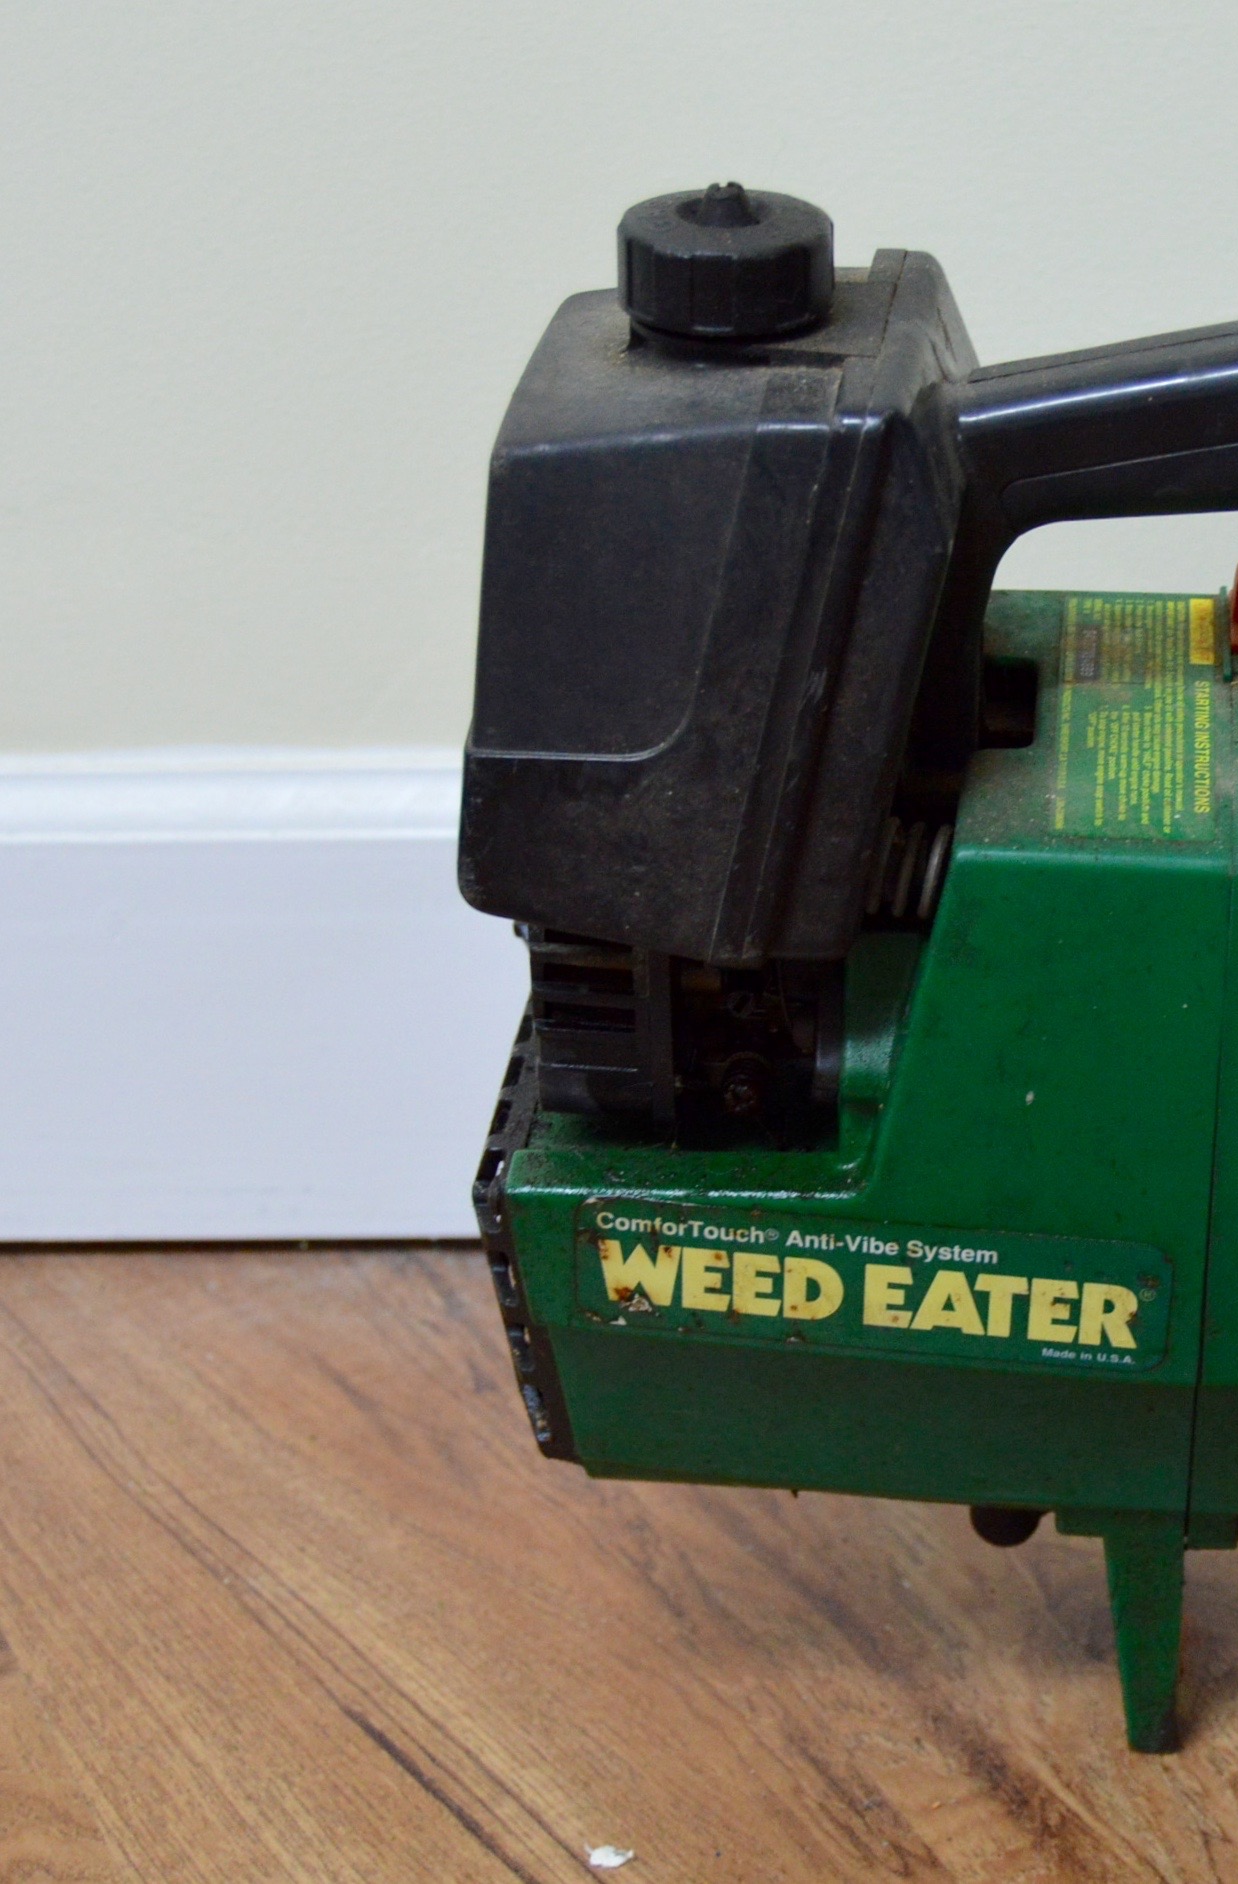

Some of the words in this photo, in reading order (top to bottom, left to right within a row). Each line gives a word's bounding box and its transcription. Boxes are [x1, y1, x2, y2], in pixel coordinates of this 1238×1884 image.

[1194, 681, 1211, 734] STARTING
[1193, 736, 1211, 814] INSTRUCTIONS
[785, 1228, 900, 1256] Anti-Vibe
[906, 1239, 999, 1265] System
[598, 1238, 845, 1321] WEED
[1041, 1347, 1077, 1360] Made
[1080, 1350, 1093, 1361] in
